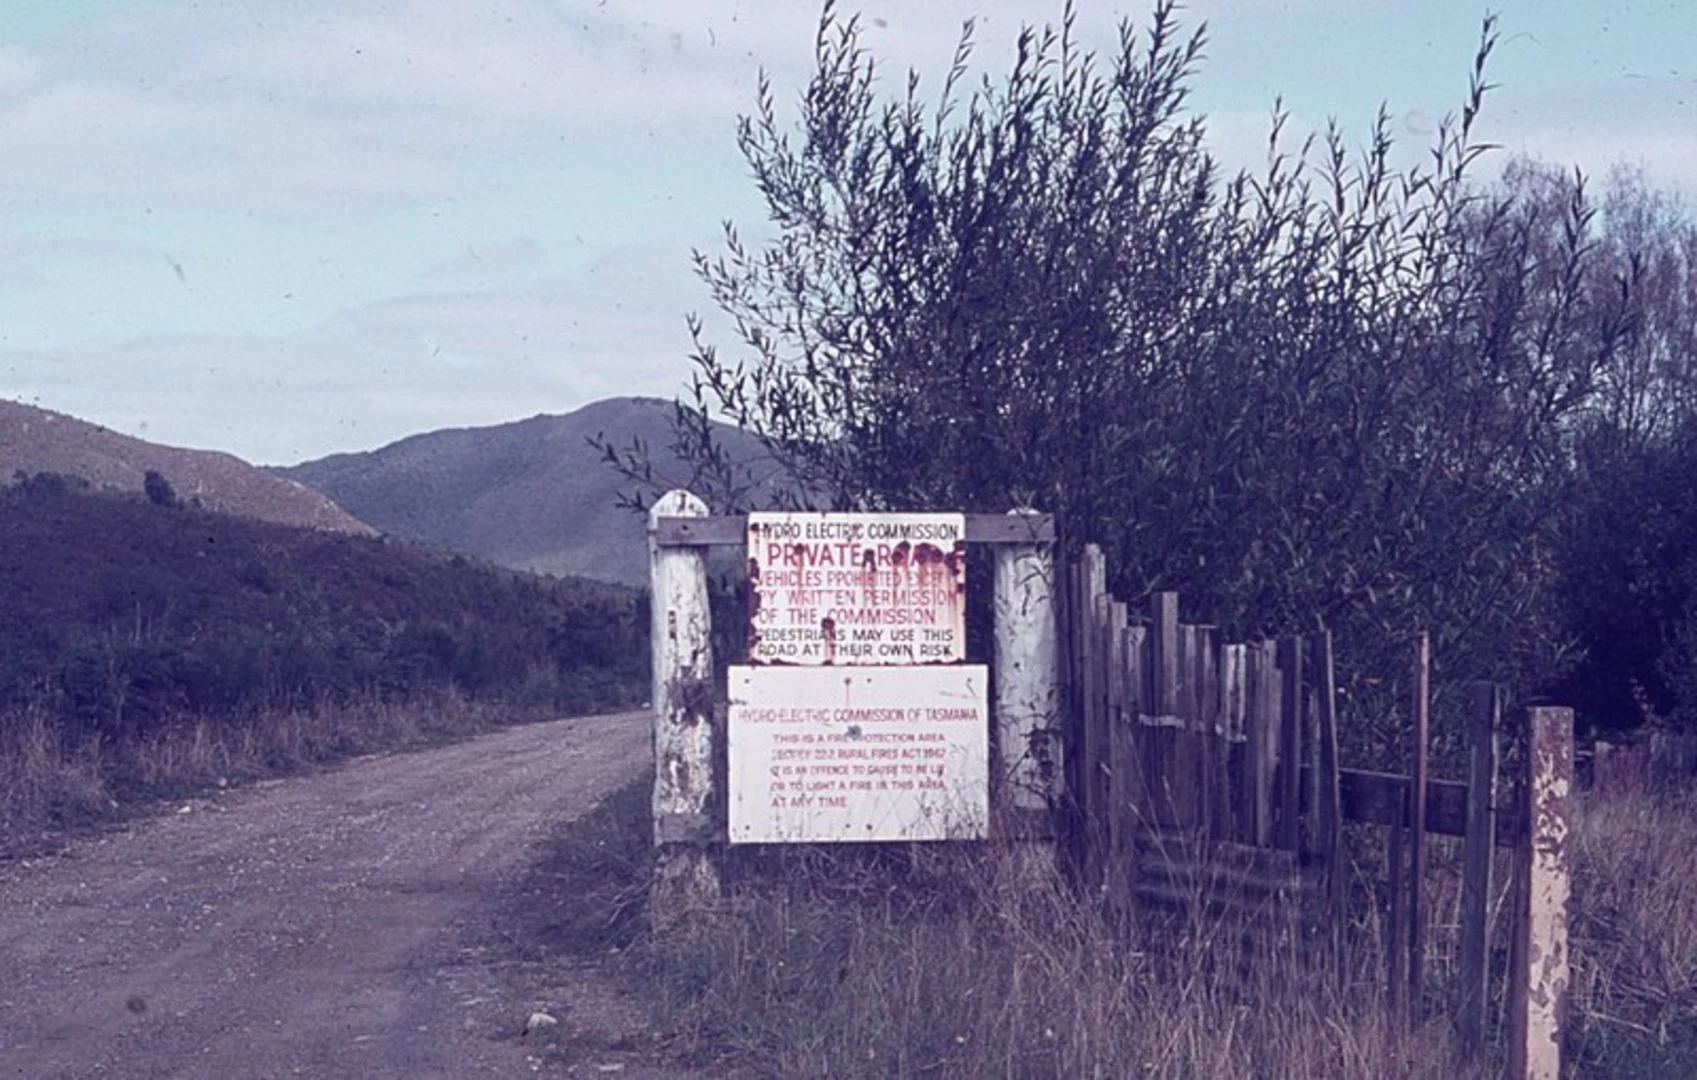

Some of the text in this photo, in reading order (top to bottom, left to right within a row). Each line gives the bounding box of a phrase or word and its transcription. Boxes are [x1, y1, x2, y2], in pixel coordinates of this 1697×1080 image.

[762, 523, 958, 540] HYDRO ELECTRIC COMMISSION
[767, 542, 944, 567] PRIVATE ROA
[785, 590, 856, 606] WRITTEN
[863, 589, 957, 606] PERMISSION
[758, 608, 936, 625] OF THE COMMISSION
[757, 629, 954, 642] PEDESTRIAS MAY USE THIS
[757, 643, 953, 657] ROAD AT THEIR OWN RISK
[833, 708, 904, 722] COMMISSION
[907, 708, 920, 722] OF
[925, 708, 979, 722] TASMANIA
[773, 732, 945, 743] THIS IS A FIRE OTECTION AREA
[901, 748, 921, 759] ACT
[782, 766, 793, 775] IS
[852, 765, 865, 775] TO
[901, 765, 912, 775] TO
[789, 780, 802, 791] TO
[806, 780, 836, 791] LIGHT
[839, 780, 847, 791] A
[850, 780, 872, 790] FIRE
[892, 780, 914, 790] THIS
[771, 797, 786, 808] AT
[818, 797, 848, 808] TIME
